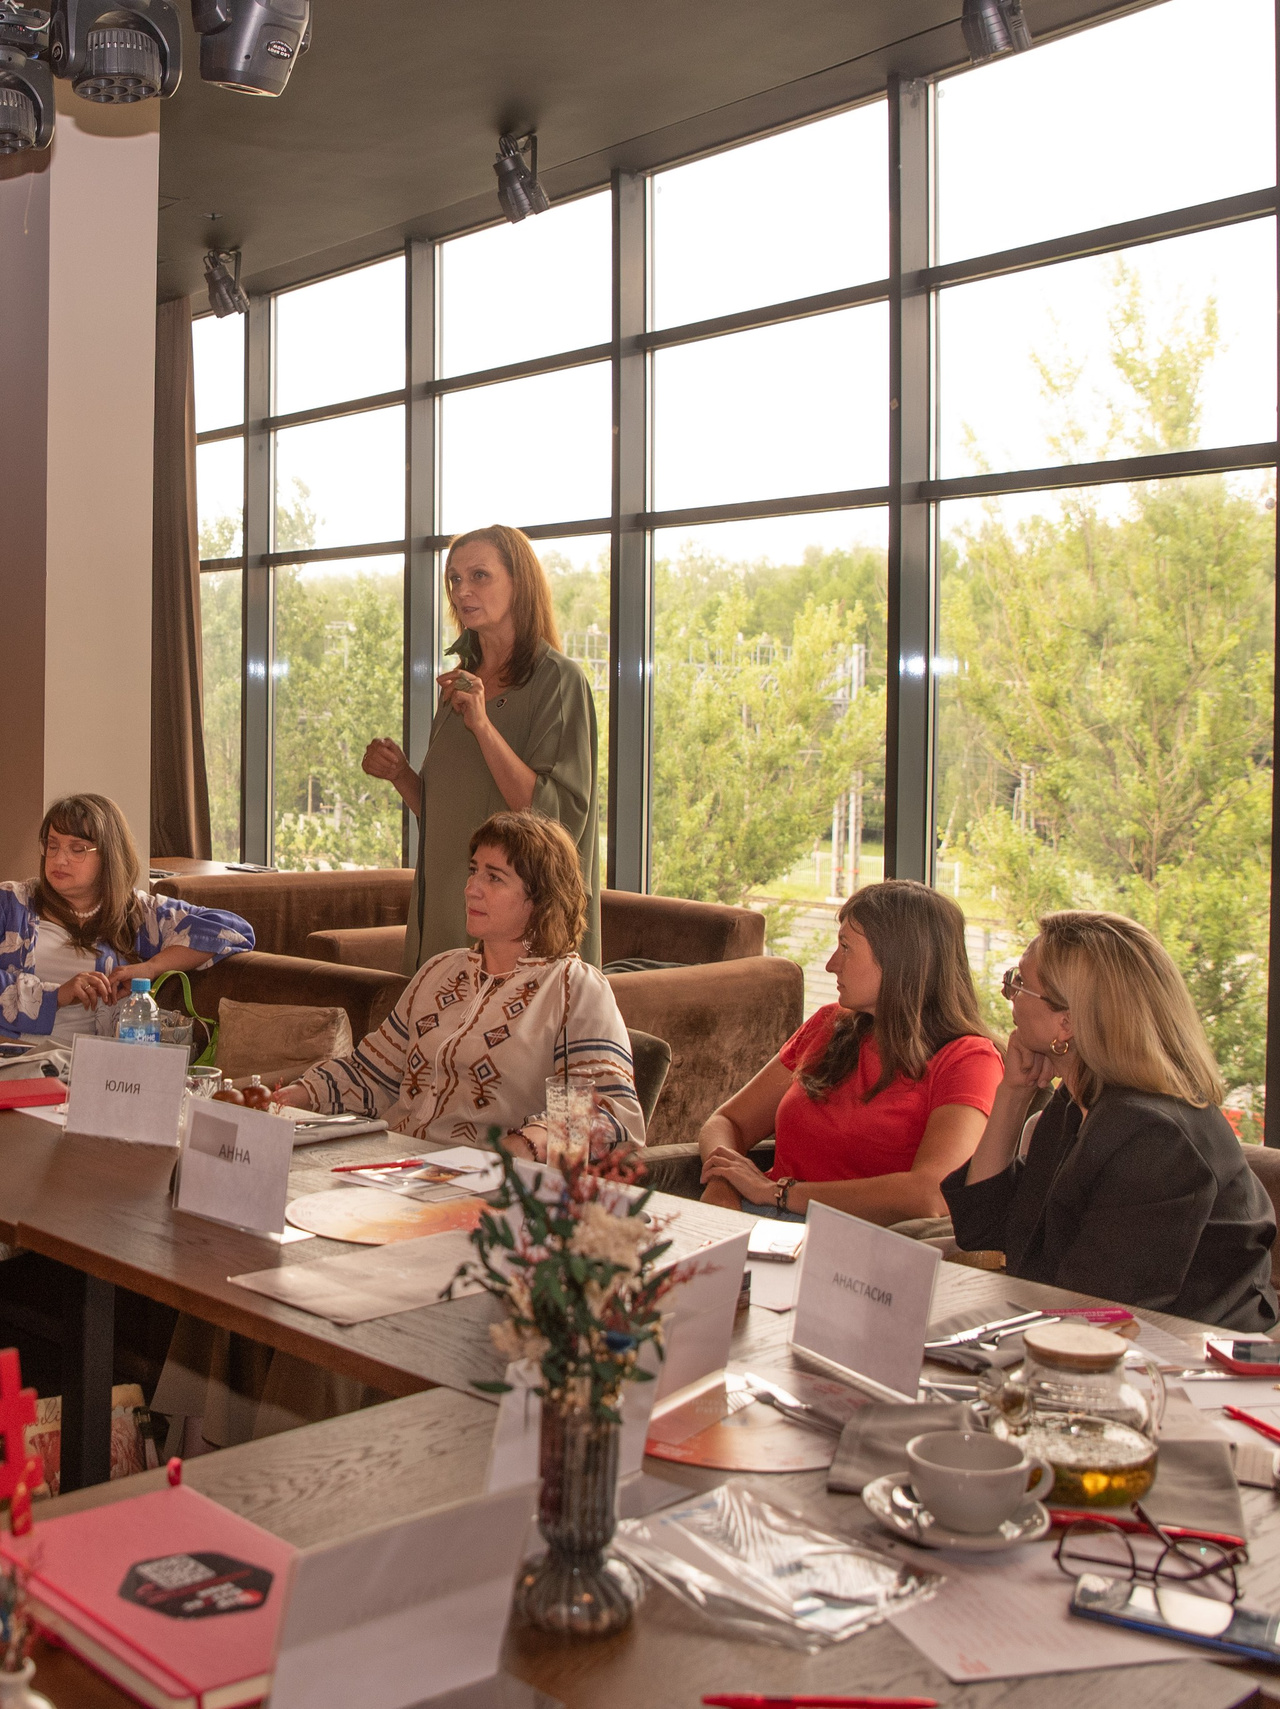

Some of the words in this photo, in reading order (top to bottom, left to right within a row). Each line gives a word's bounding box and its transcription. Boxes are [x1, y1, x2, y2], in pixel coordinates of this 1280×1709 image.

[104, 1079, 141, 1095] ЮЛИЯ
[218, 1143, 251, 1165] АННА
[832, 1271, 893, 1307] АНАСТАСИЯ
